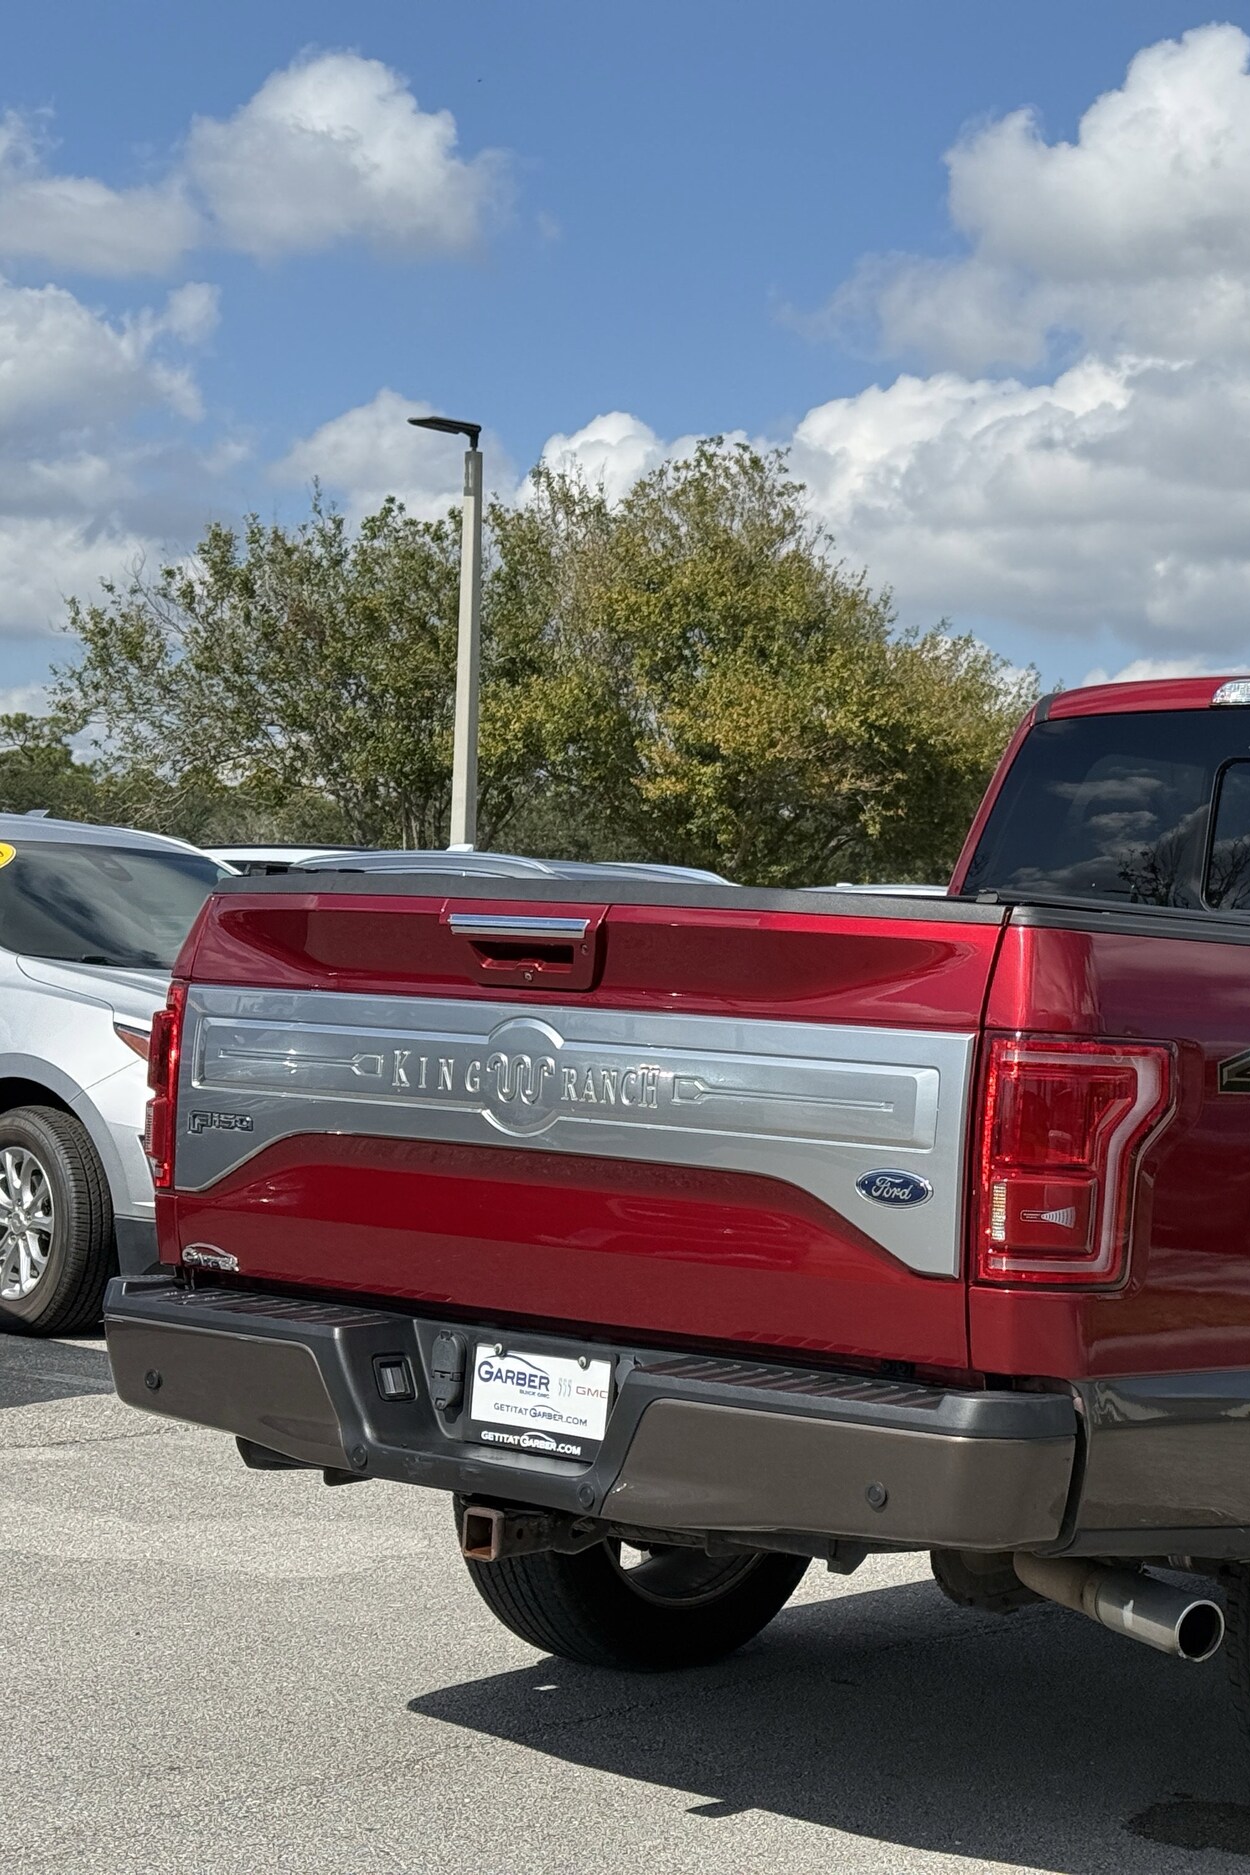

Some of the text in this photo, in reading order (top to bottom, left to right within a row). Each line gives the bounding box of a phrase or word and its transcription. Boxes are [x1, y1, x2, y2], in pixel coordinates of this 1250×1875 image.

[391, 1050, 662, 1109] KING RANCH
[871, 1176, 914, 1200] Ford
[478, 1360, 550, 1391] GARBER
[575, 1385, 609, 1399] GMC
